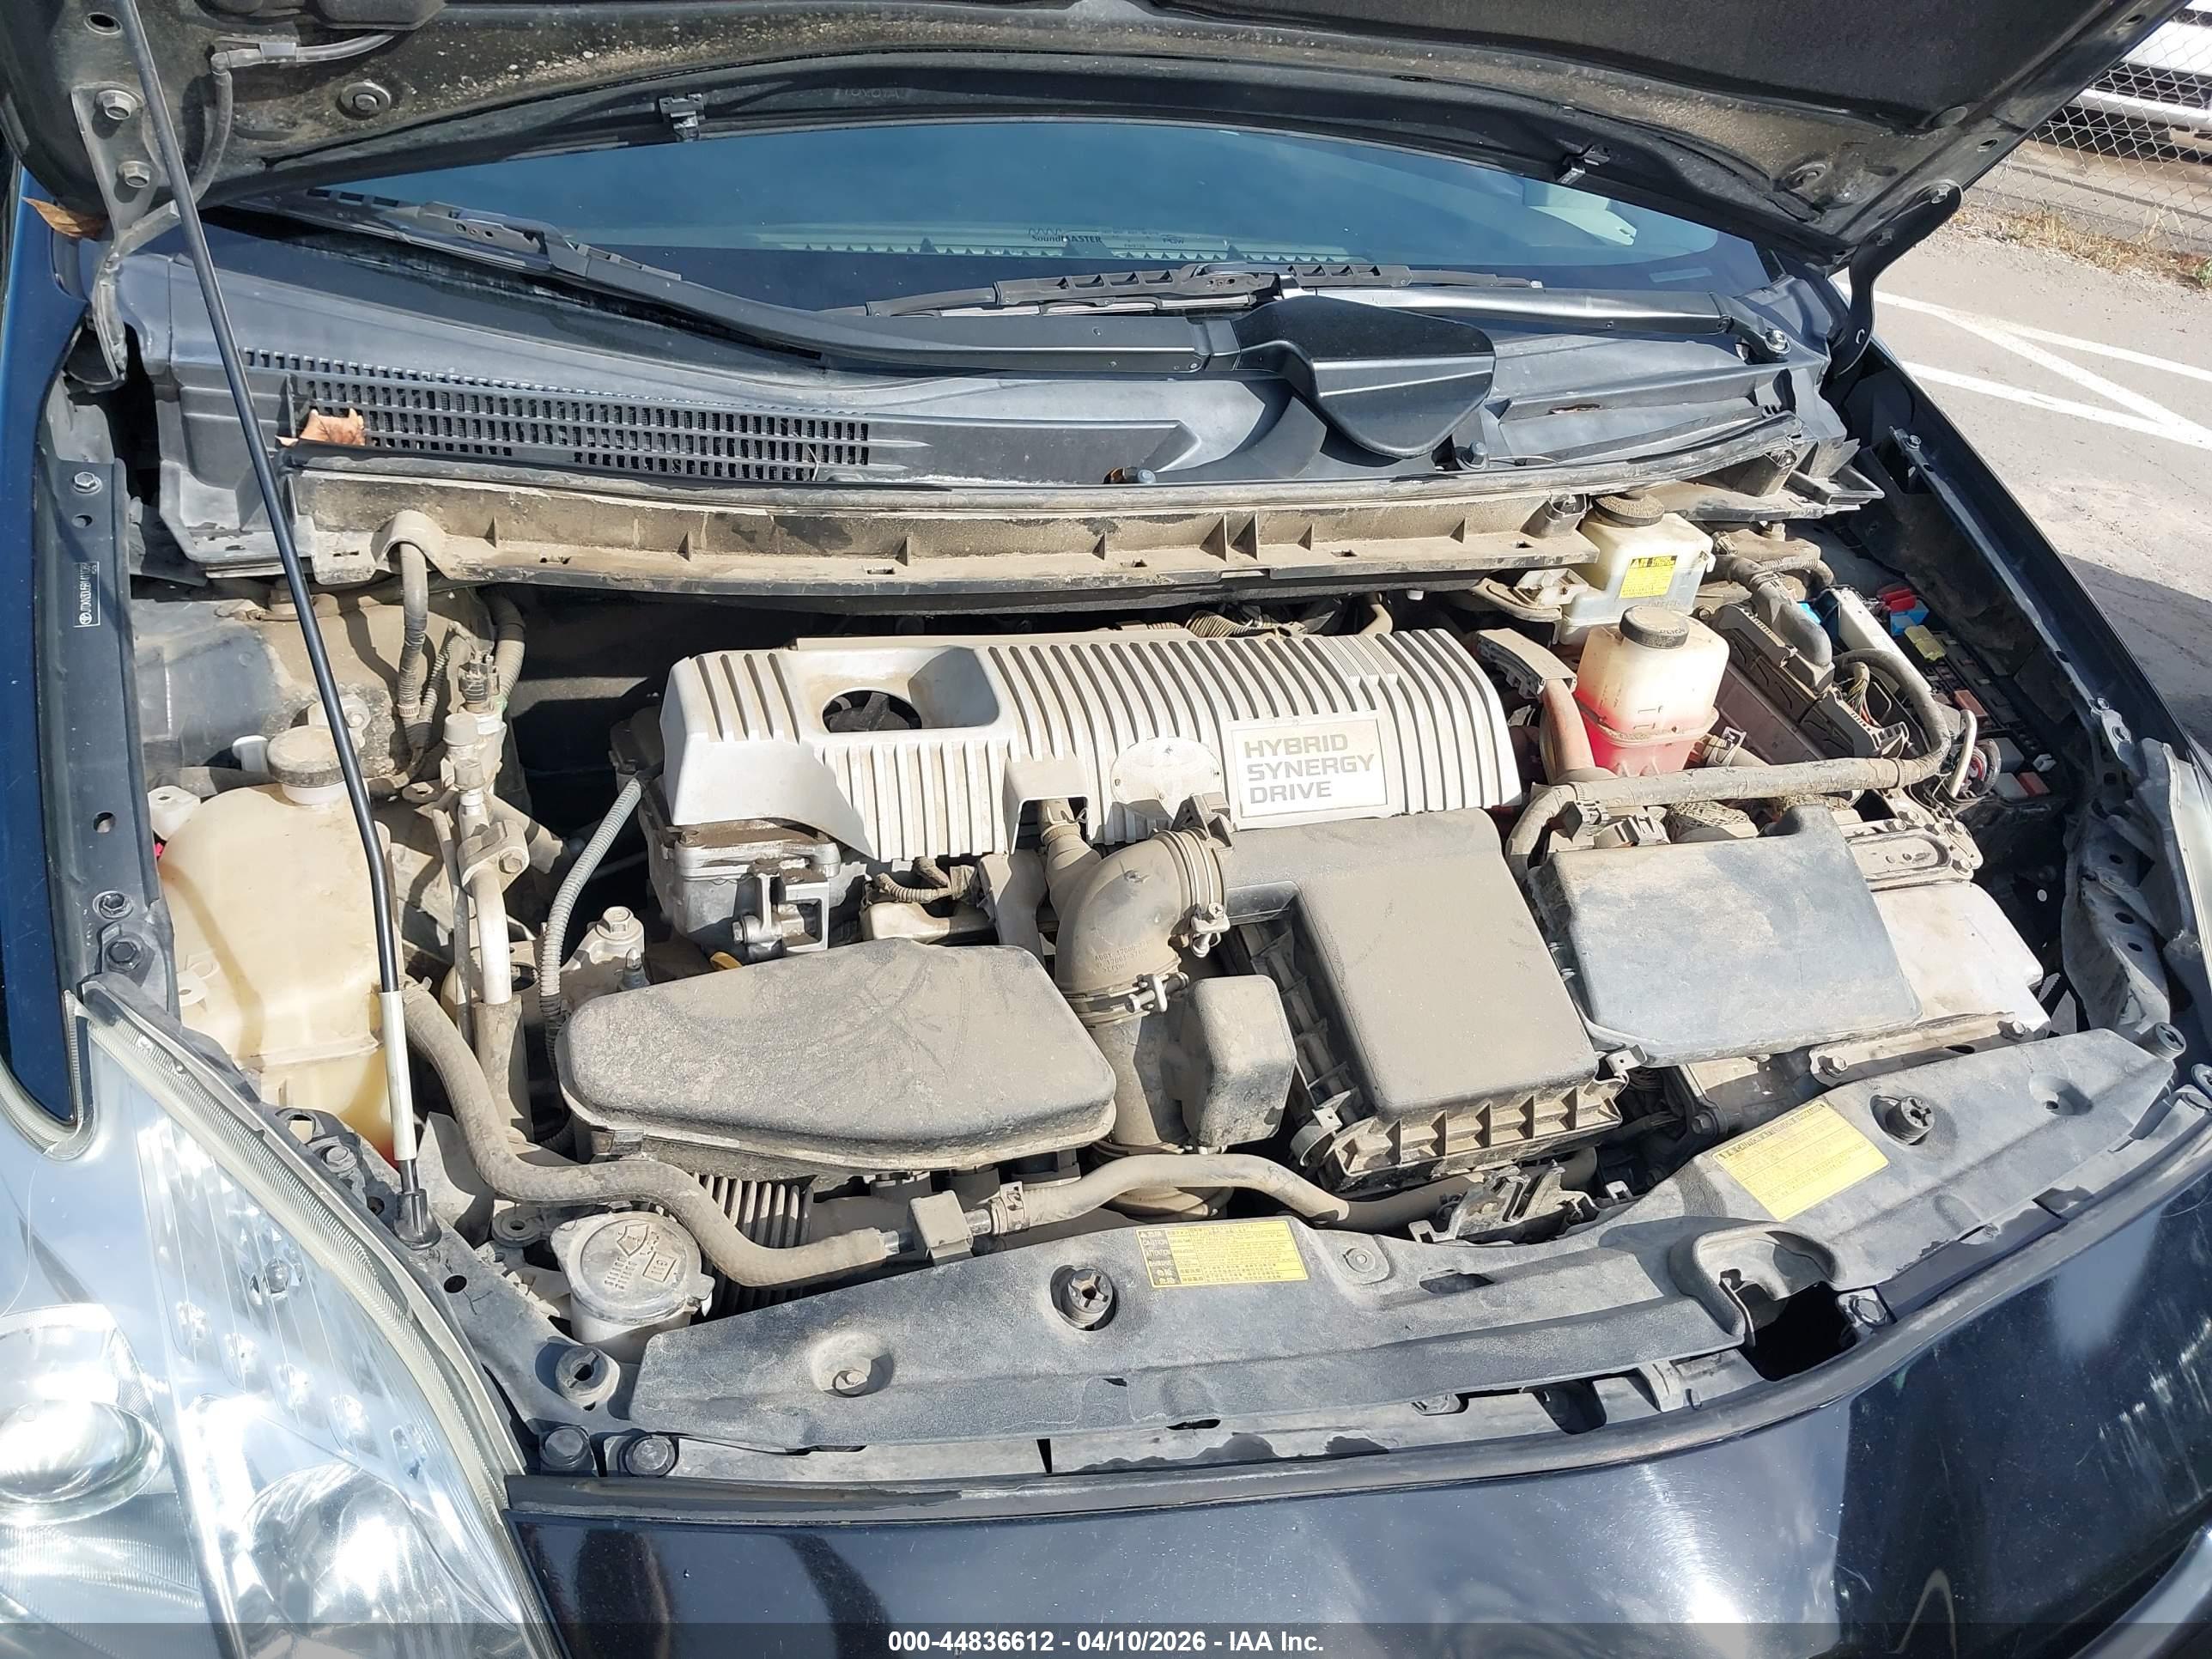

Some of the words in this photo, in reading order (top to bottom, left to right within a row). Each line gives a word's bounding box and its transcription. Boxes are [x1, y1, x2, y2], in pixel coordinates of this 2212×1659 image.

[1244, 733, 1348, 759] HYBRID
[1247, 753, 1375, 782] SYNERGY
[1249, 781, 1332, 805] DRIVE
